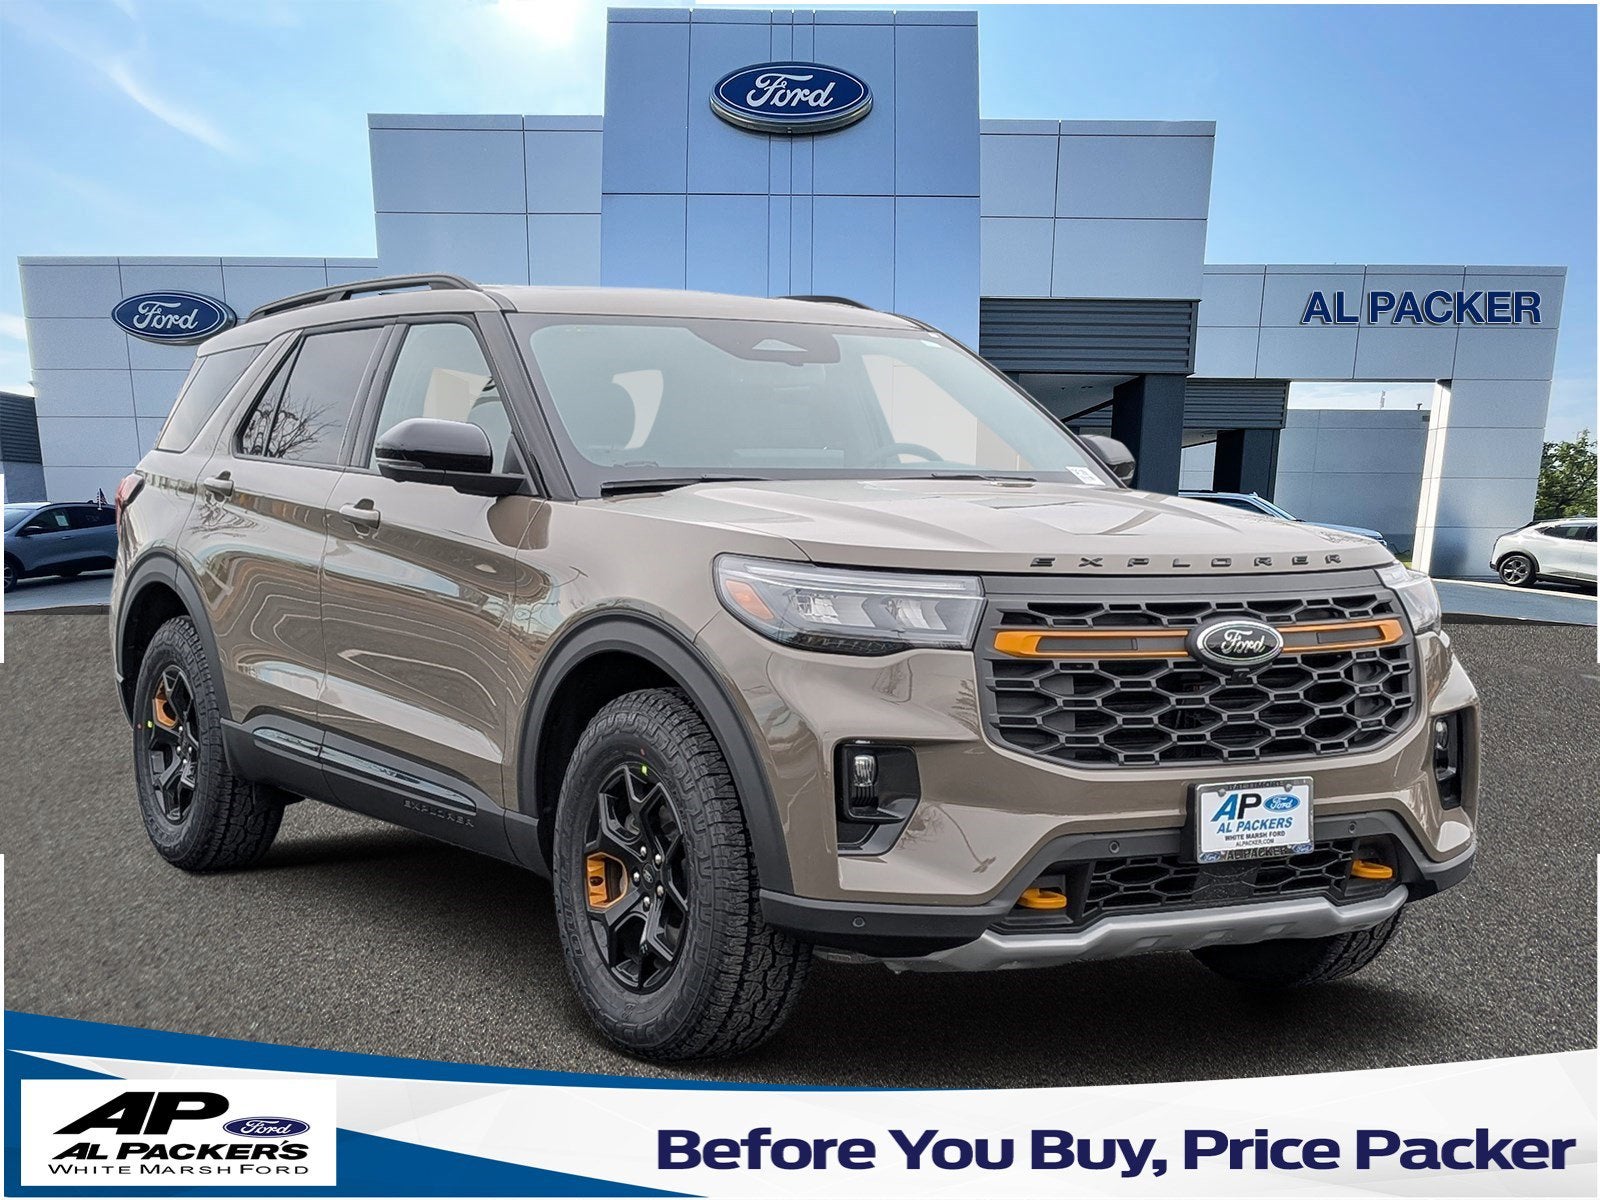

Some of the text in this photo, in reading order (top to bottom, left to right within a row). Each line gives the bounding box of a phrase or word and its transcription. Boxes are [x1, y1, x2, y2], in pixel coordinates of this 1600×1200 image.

[746, 73, 836, 107] Ford
[133, 301, 198, 329] Ford
[1302, 290, 1542, 324] AL PACKER
[1030, 555, 1342, 568] EXPLORER
[1221, 629, 1266, 654] Ford
[1210, 793, 1262, 822] AP
[1270, 797, 1293, 810] Ford
[1216, 817, 1293, 834] AL PACKERS
[1225, 830, 1286, 841] WHITE MARSH FORD
[1235, 838, 1274, 847] ALPACKER.COM
